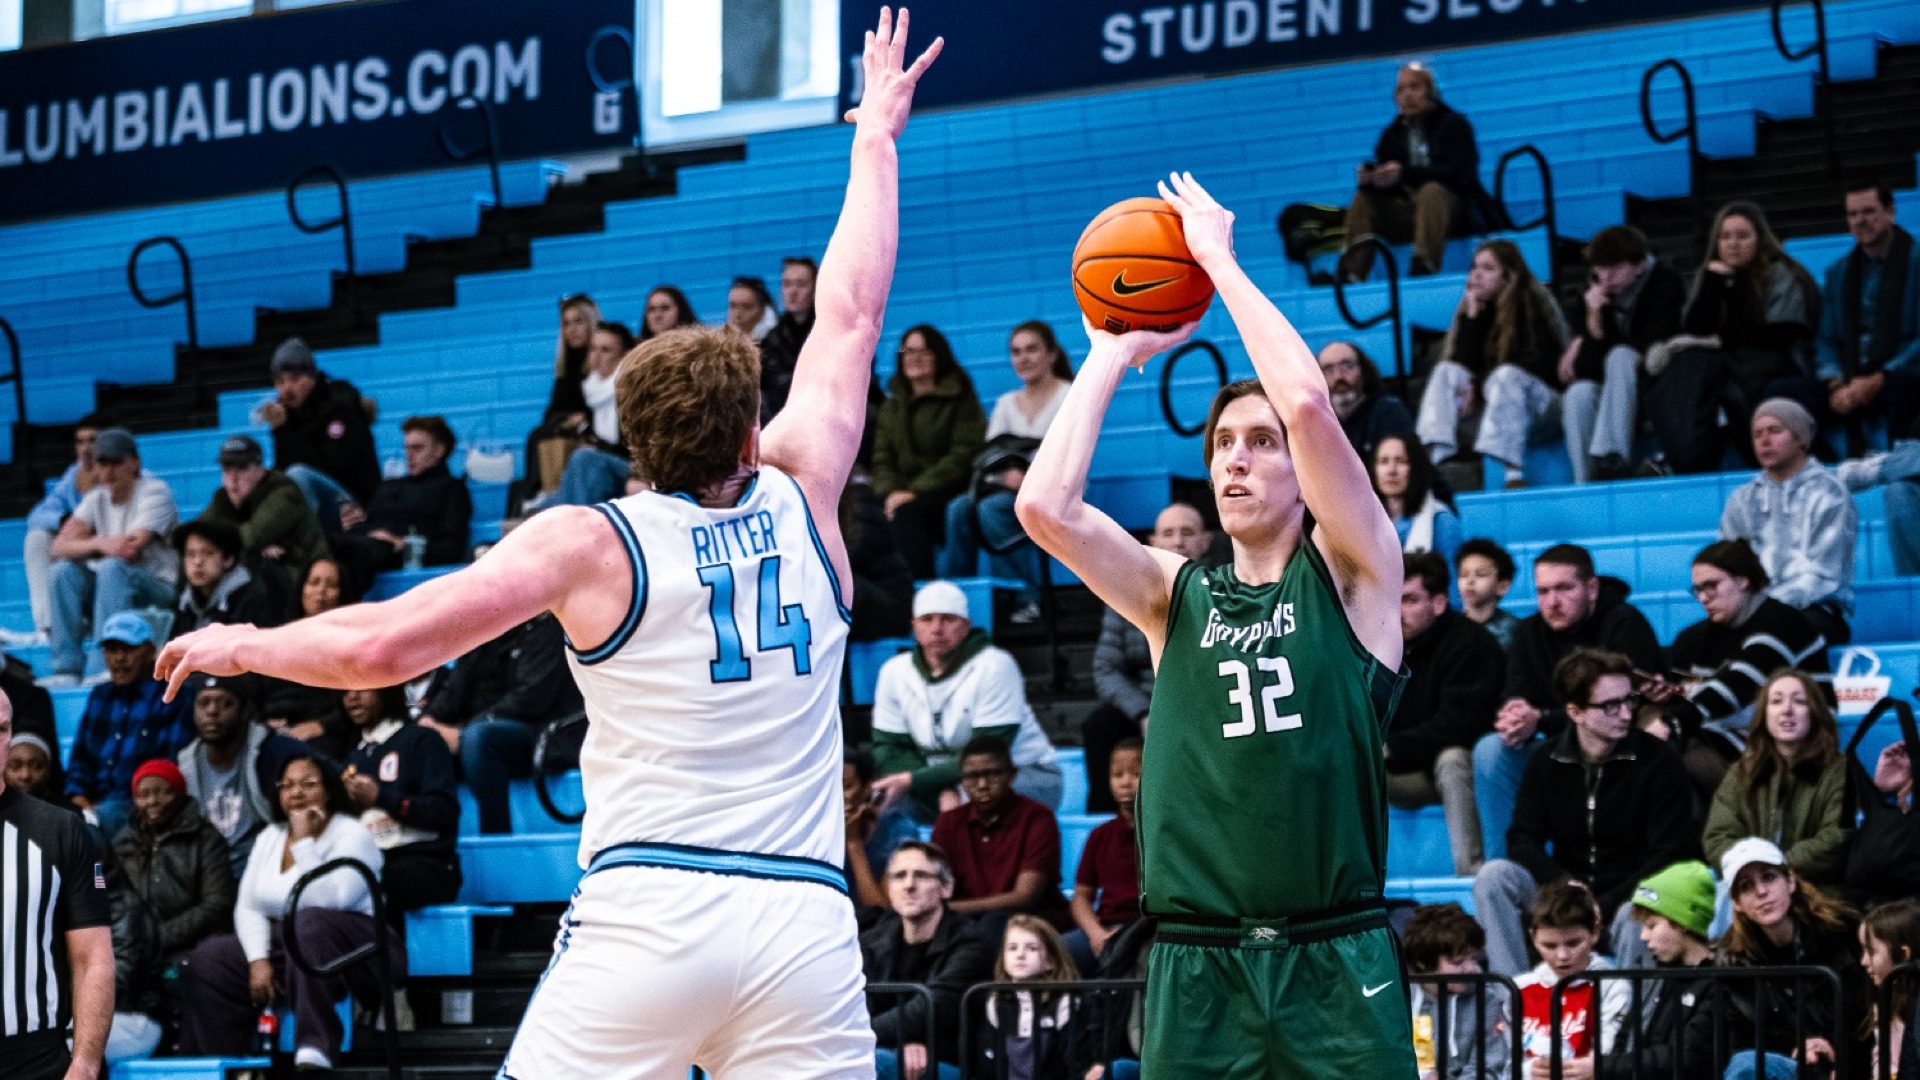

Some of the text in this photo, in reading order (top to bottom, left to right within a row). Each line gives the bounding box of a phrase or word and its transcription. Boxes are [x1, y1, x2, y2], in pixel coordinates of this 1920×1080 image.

[0, 37, 541, 167] LUMBIALIONS.COM
[691, 510, 778, 564] RITTER
[696, 555, 812, 683] 14
[1200, 603, 1296, 653] GRYPNS
[1218, 656, 1303, 738] 32
